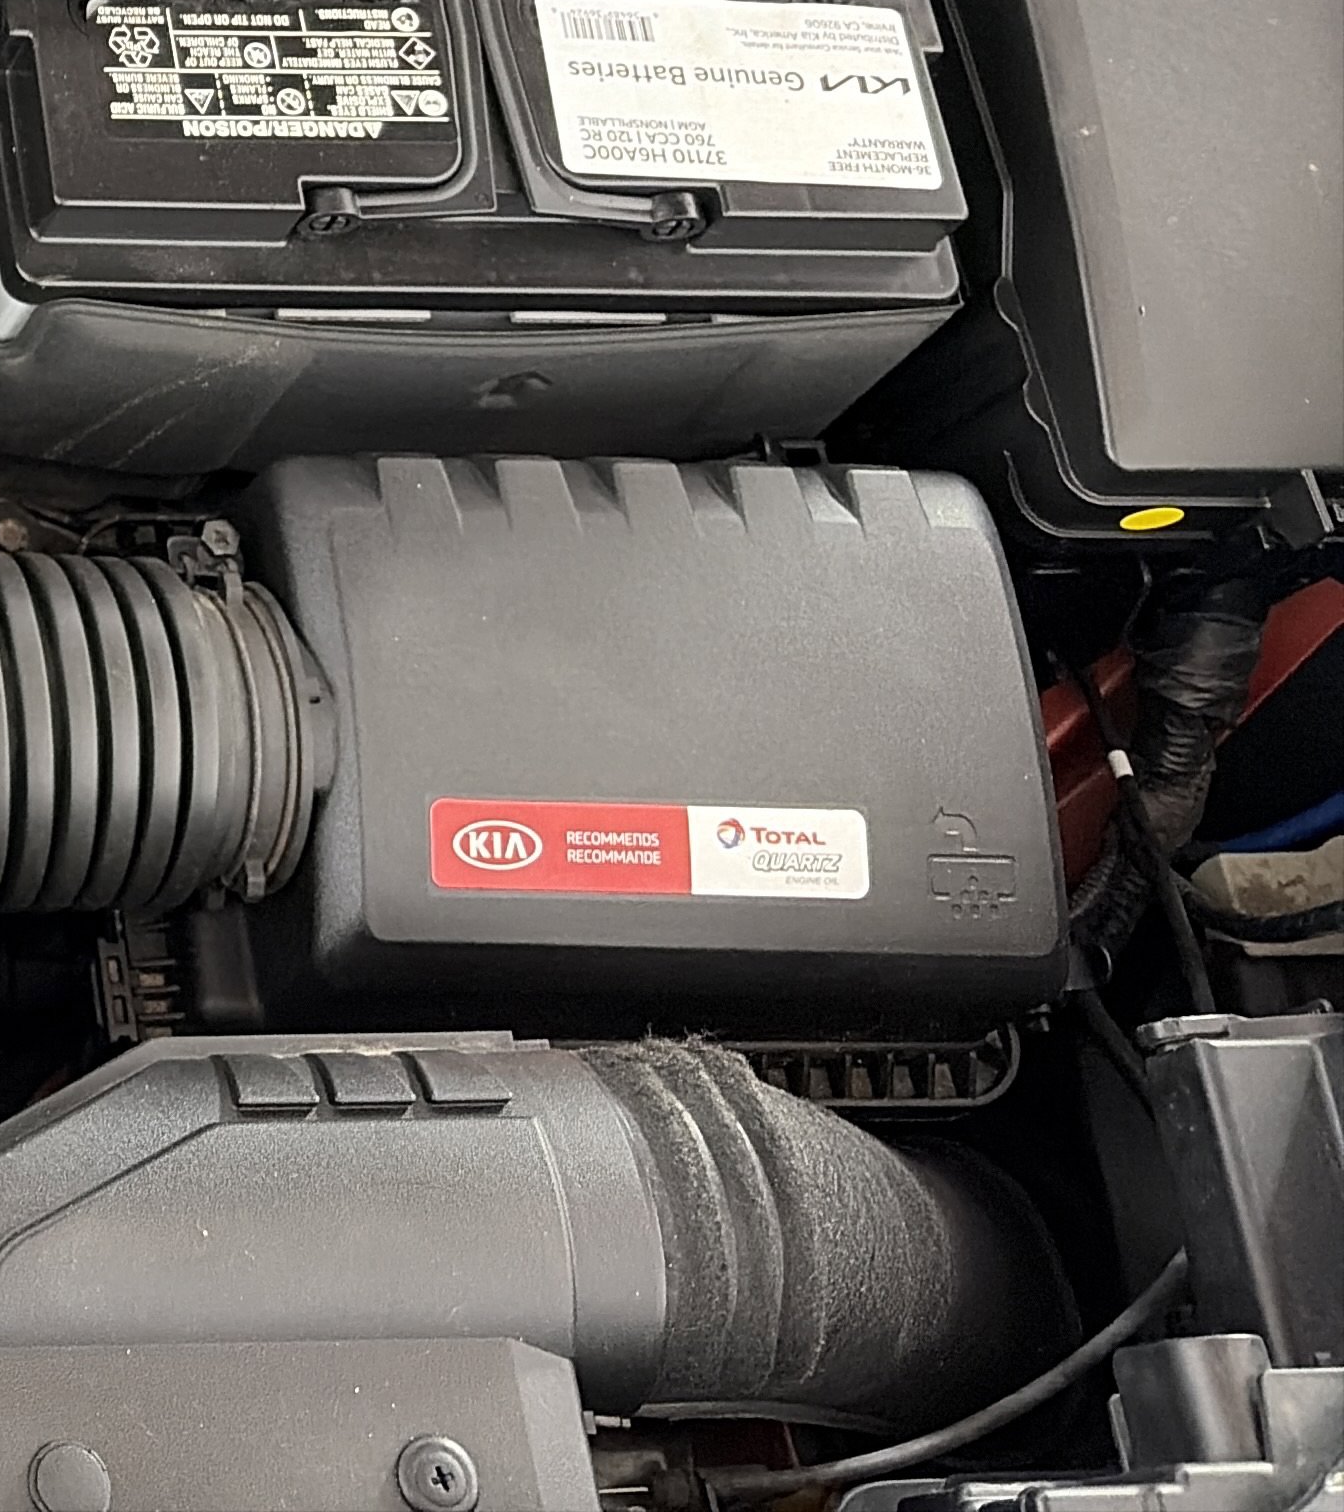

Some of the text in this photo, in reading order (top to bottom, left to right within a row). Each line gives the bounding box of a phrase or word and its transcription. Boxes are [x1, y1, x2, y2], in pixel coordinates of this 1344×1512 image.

[97, 7, 145, 16] RECYCLED
[96, 15, 164, 25] BATTERY MUST
[180, 14, 290, 27] DO NOT TIP OR OPEN.
[364, 20, 391, 30] READ
[841, 20, 861, 31] CA
[749, 26, 799, 40] America,
[862, 21, 896, 33] Irvine,
[800, 30, 820, 41] Kia
[822, 28, 837, 42] by
[838, 31, 900, 46] Distributed
[329, 38, 353, 49] HELP
[353, 38, 395, 49] MEDICAL
[190, 47, 222, 57] REACH
[199, 57, 218, 68] OUT
[219, 57, 243, 68] KEEP
[282, 57, 342, 68] IMMEDIATELY
[144, 73, 180, 84] SEVERE
[567, 61, 686, 86] Batteries
[693, 67, 805, 91] Genuine
[116, 82, 182, 94] BLINDNESS OR
[132, 92, 162, 104] CAUSE
[110, 102, 185, 115] SULFURIC ACID
[182, 119, 366, 138] DANGER/POISON
[576, 116, 706, 132] AGM NONSPILLABLE
[579, 128, 716, 147] 760 CCA 120 RC
[672, 149, 728, 165] 37110
[835, 148, 929, 163] REPLACEMENT
[828, 161, 932, 175] 36-MONTH FREE
[565, 829, 661, 848] RECOMMENDS
[749, 827, 827, 846] TOTAL
[468, 830, 529, 859] KIA
[566, 848, 662, 866] RECOMMANDE
[752, 849, 843, 873] QUARTZ
[784, 876, 840, 886] ENGINE OIL
